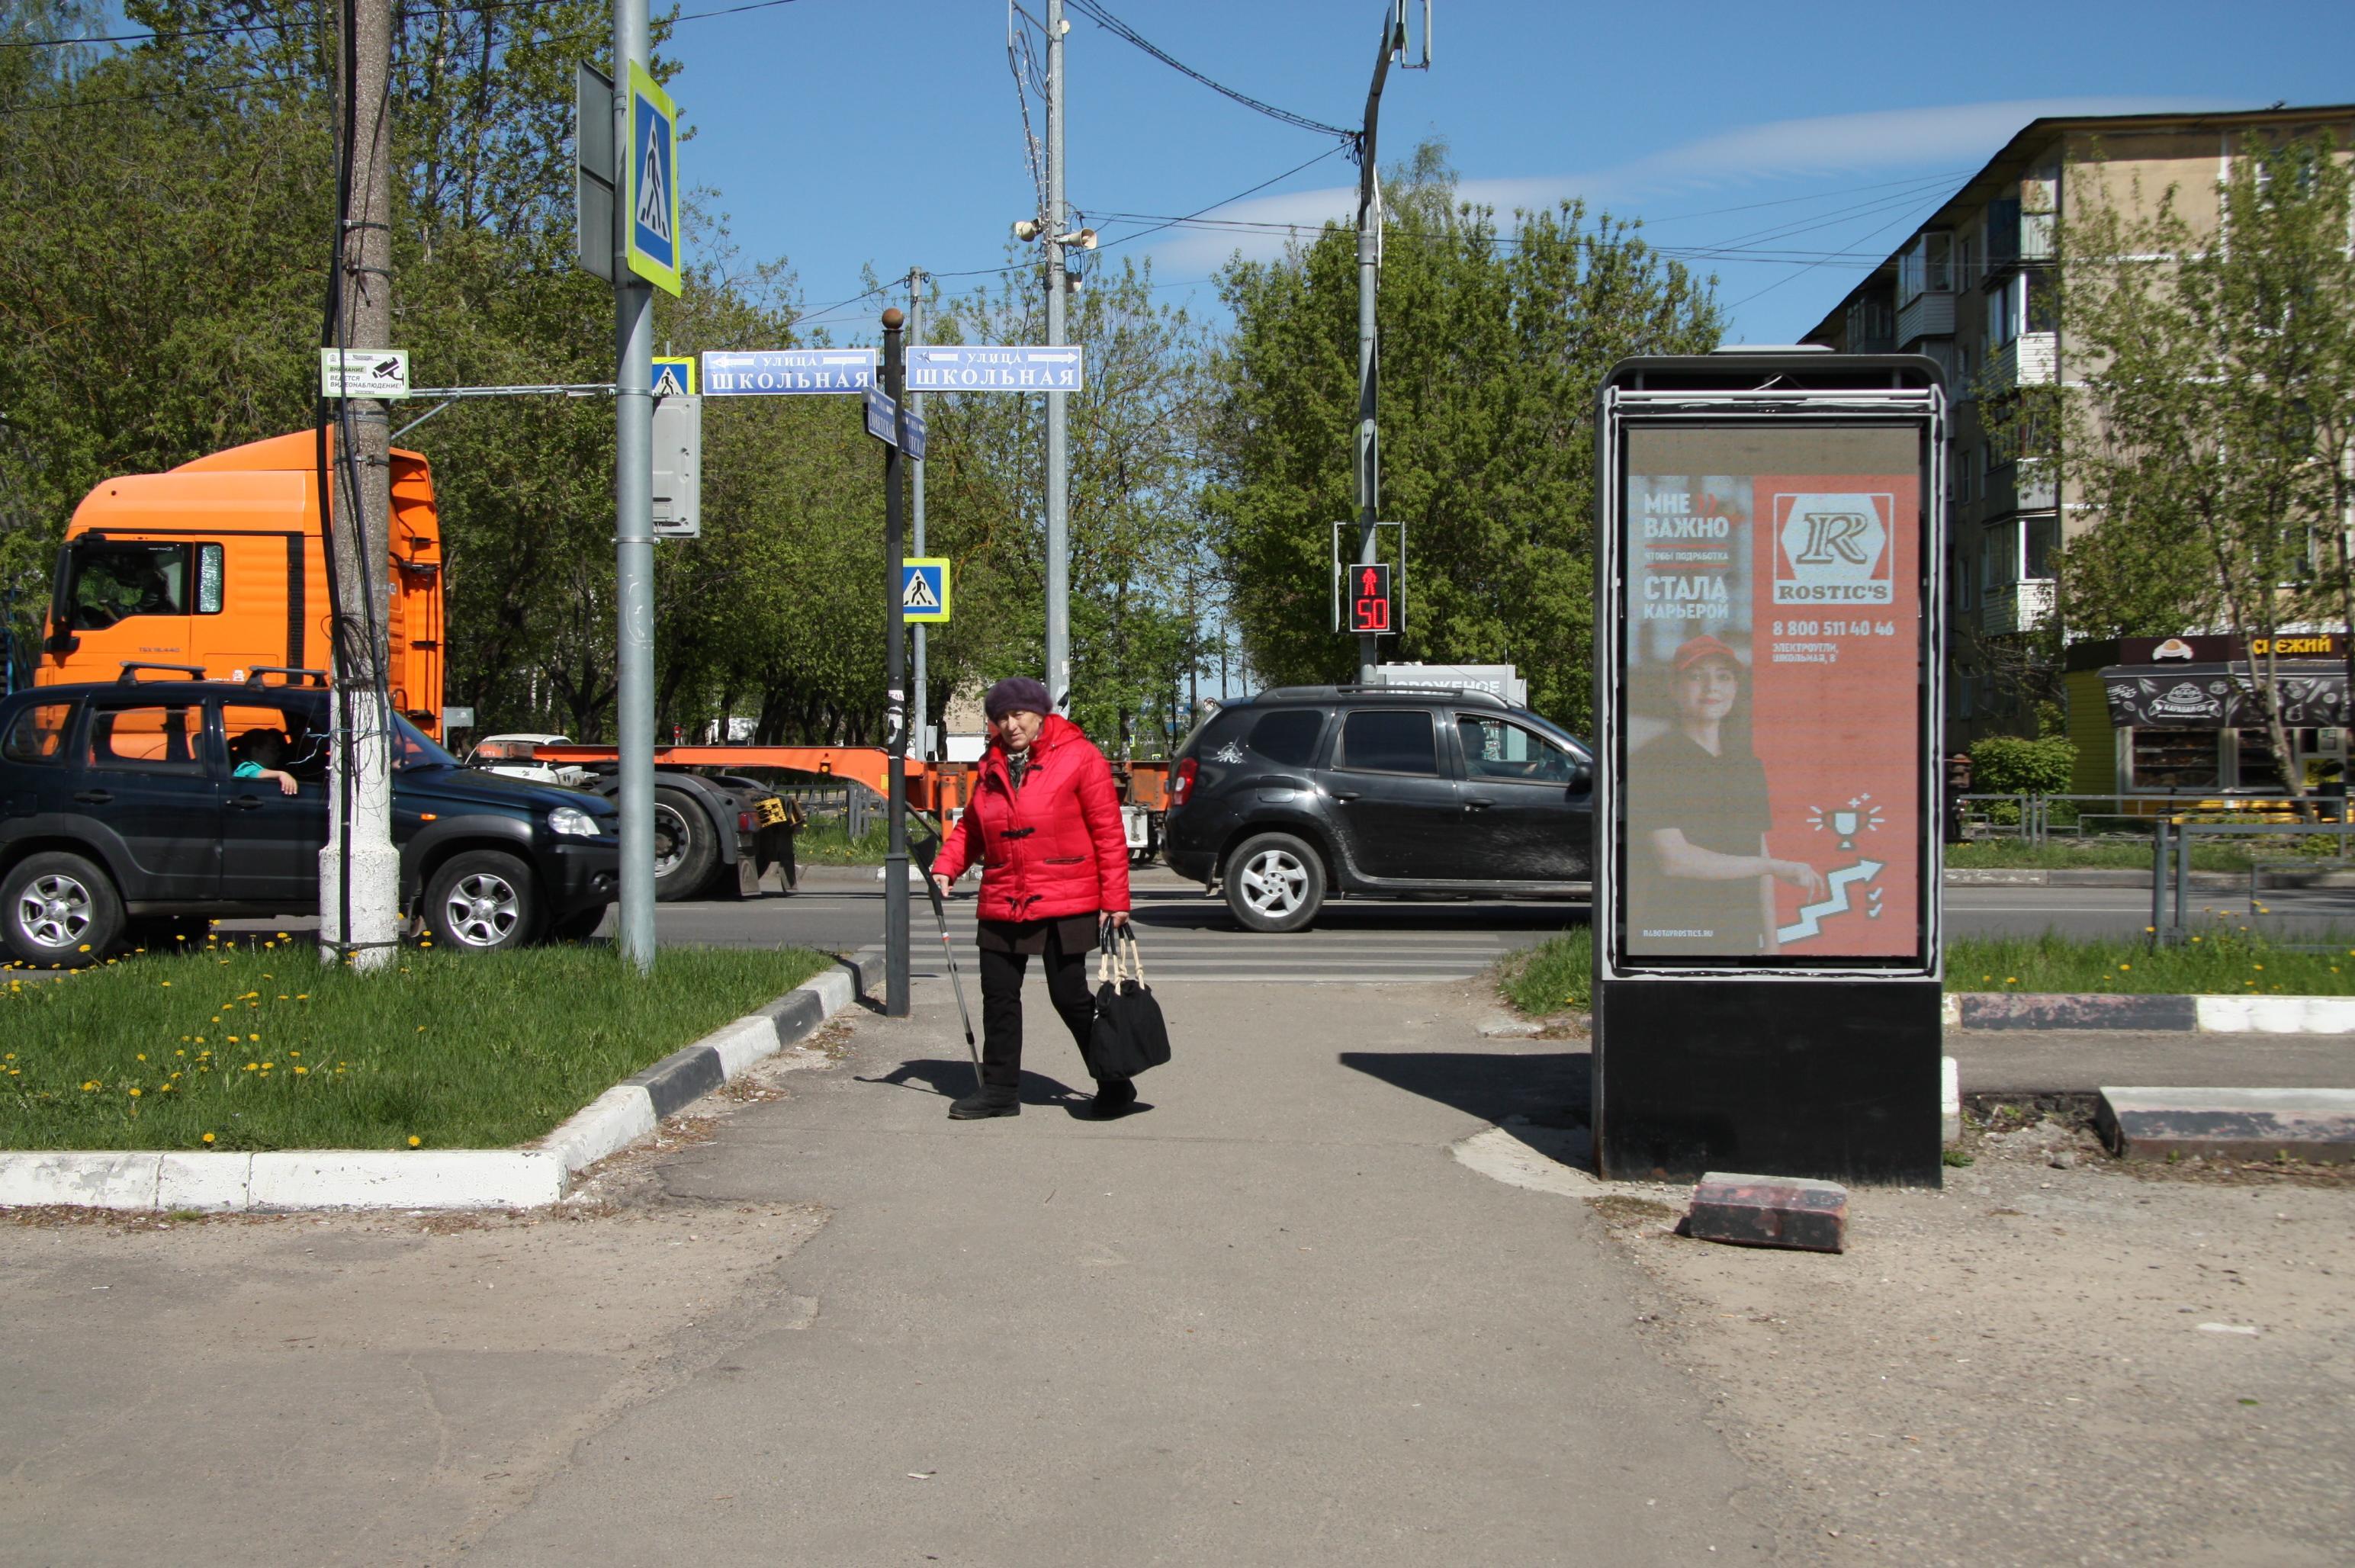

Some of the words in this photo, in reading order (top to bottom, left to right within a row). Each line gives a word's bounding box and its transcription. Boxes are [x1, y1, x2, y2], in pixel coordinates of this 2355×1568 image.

[763, 357, 818, 367] УЛИЦА
[968, 353, 1021, 364] УЛИЦА
[712, 371, 869, 390] ШКОЛЬНАЯ
[916, 368, 1074, 385] ШКОЛЬНАЯ
[1644, 493, 1691, 514] МНЕ
[1644, 516, 1729, 538] ВАЖНО
[1796, 512, 1868, 564] R
[1645, 551, 1673, 561] ЧТОБЫ
[1675, 551, 1729, 561] ПОДРАБОТКА
[1643, 576, 1727, 600] СТАЛА
[1778, 585, 1888, 599] ROSTIC'S
[1357, 599, 1386, 628] 50
[1643, 597, 1729, 619] КАРЬЕРОЙ
[1772, 620, 1783, 636] 8
[1787, 620, 1819, 636] 800
[1823, 620, 1846, 636] 511
[1849, 620, 1871, 636] 40
[1875, 621, 1895, 636] 46
